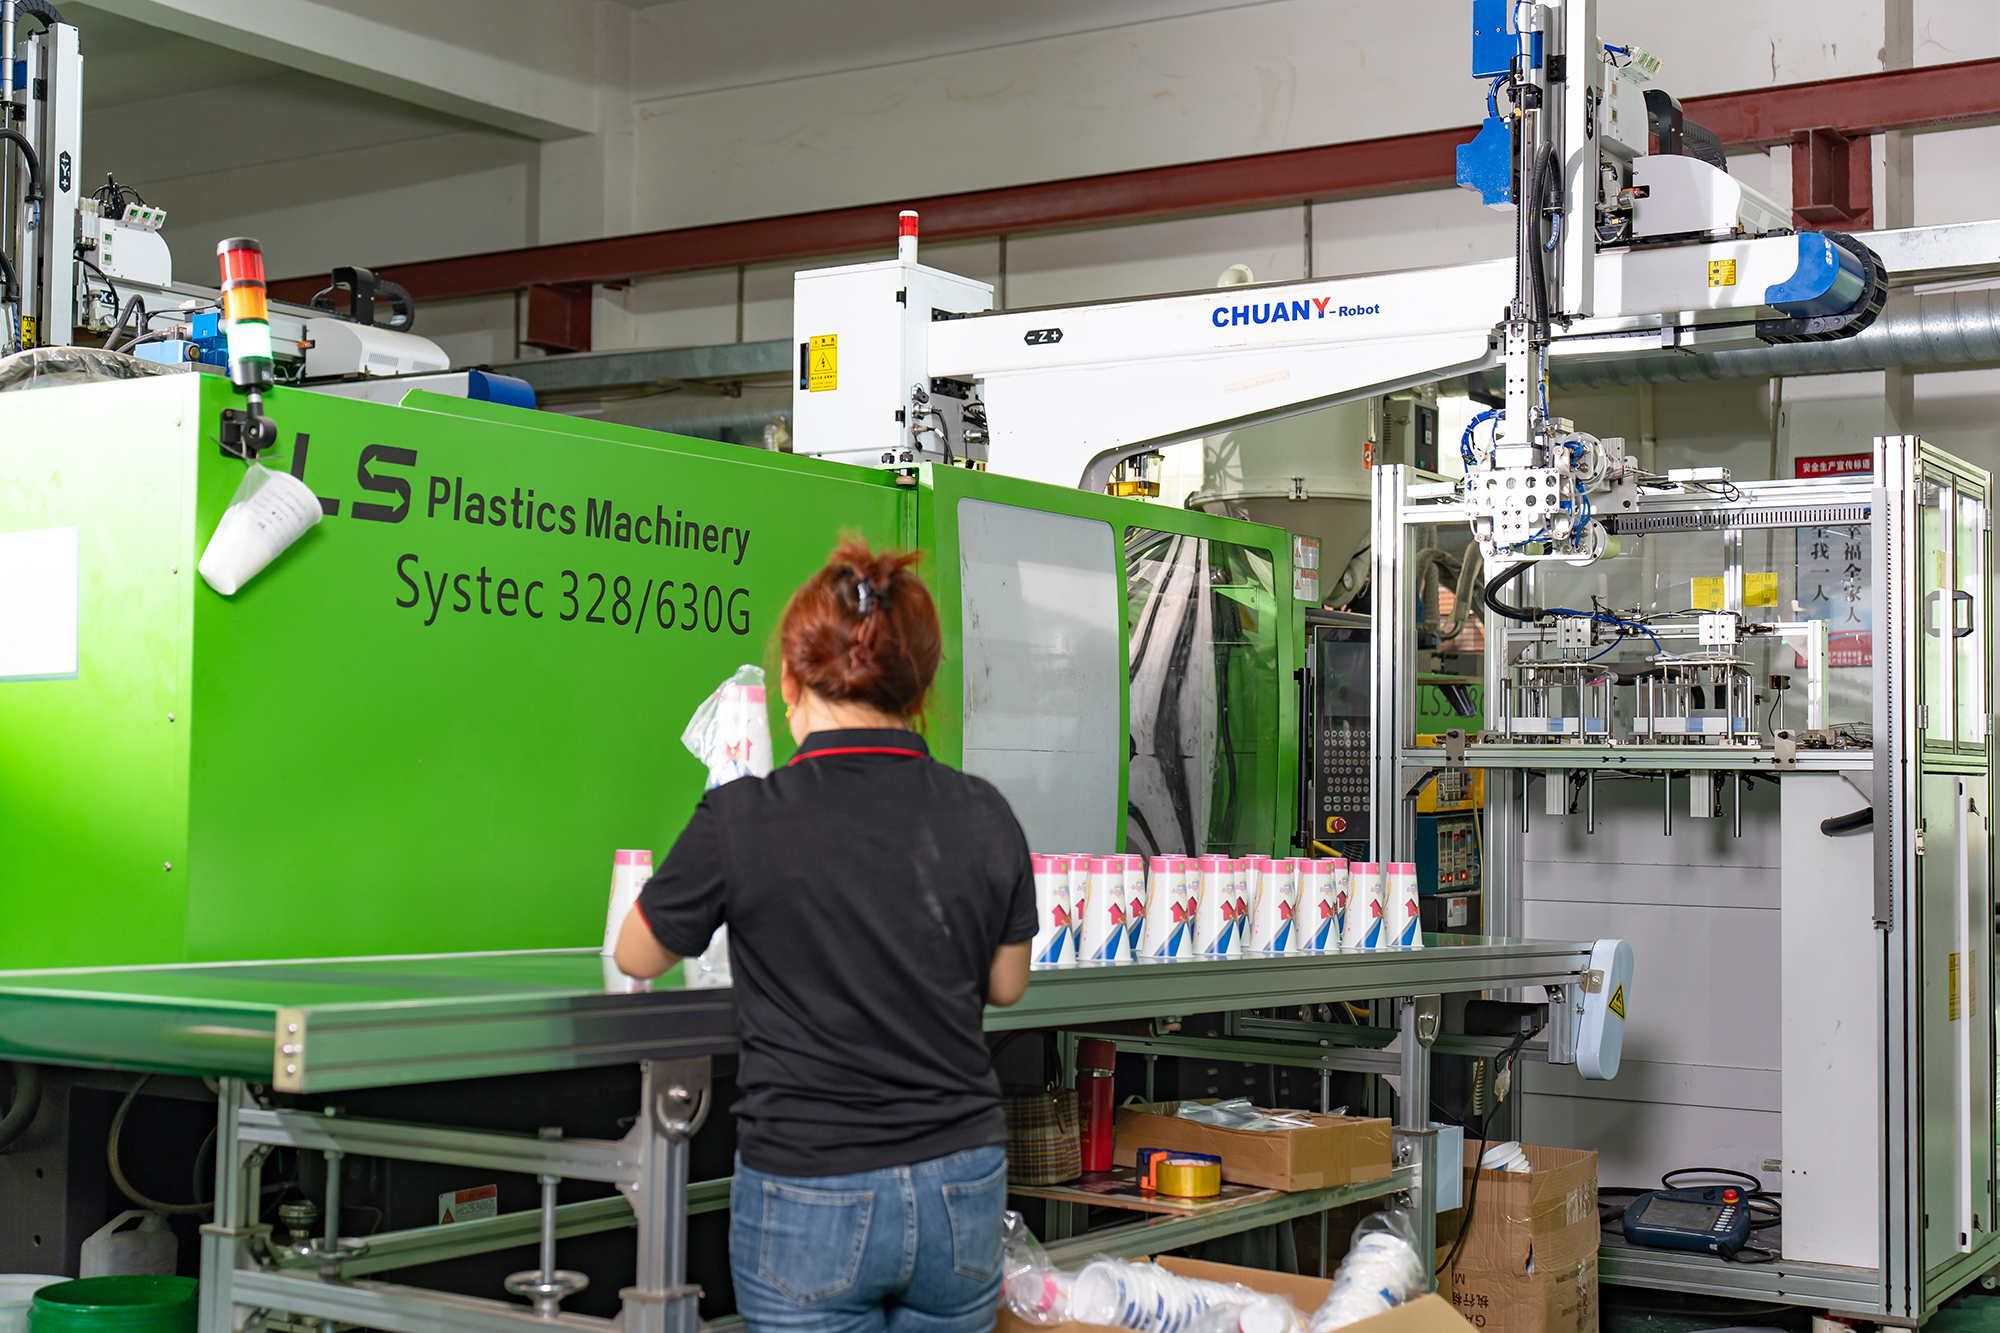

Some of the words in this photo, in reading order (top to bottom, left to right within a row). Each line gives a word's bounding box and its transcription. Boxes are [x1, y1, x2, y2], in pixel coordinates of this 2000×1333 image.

[1802, 459, 1870, 474] 安全生产宣传标语
[427, 475, 577, 536] Plastics
[585, 497, 751, 566] Machinery
[395, 553, 545, 627] Systec
[559, 569, 751, 636] 328/630G
